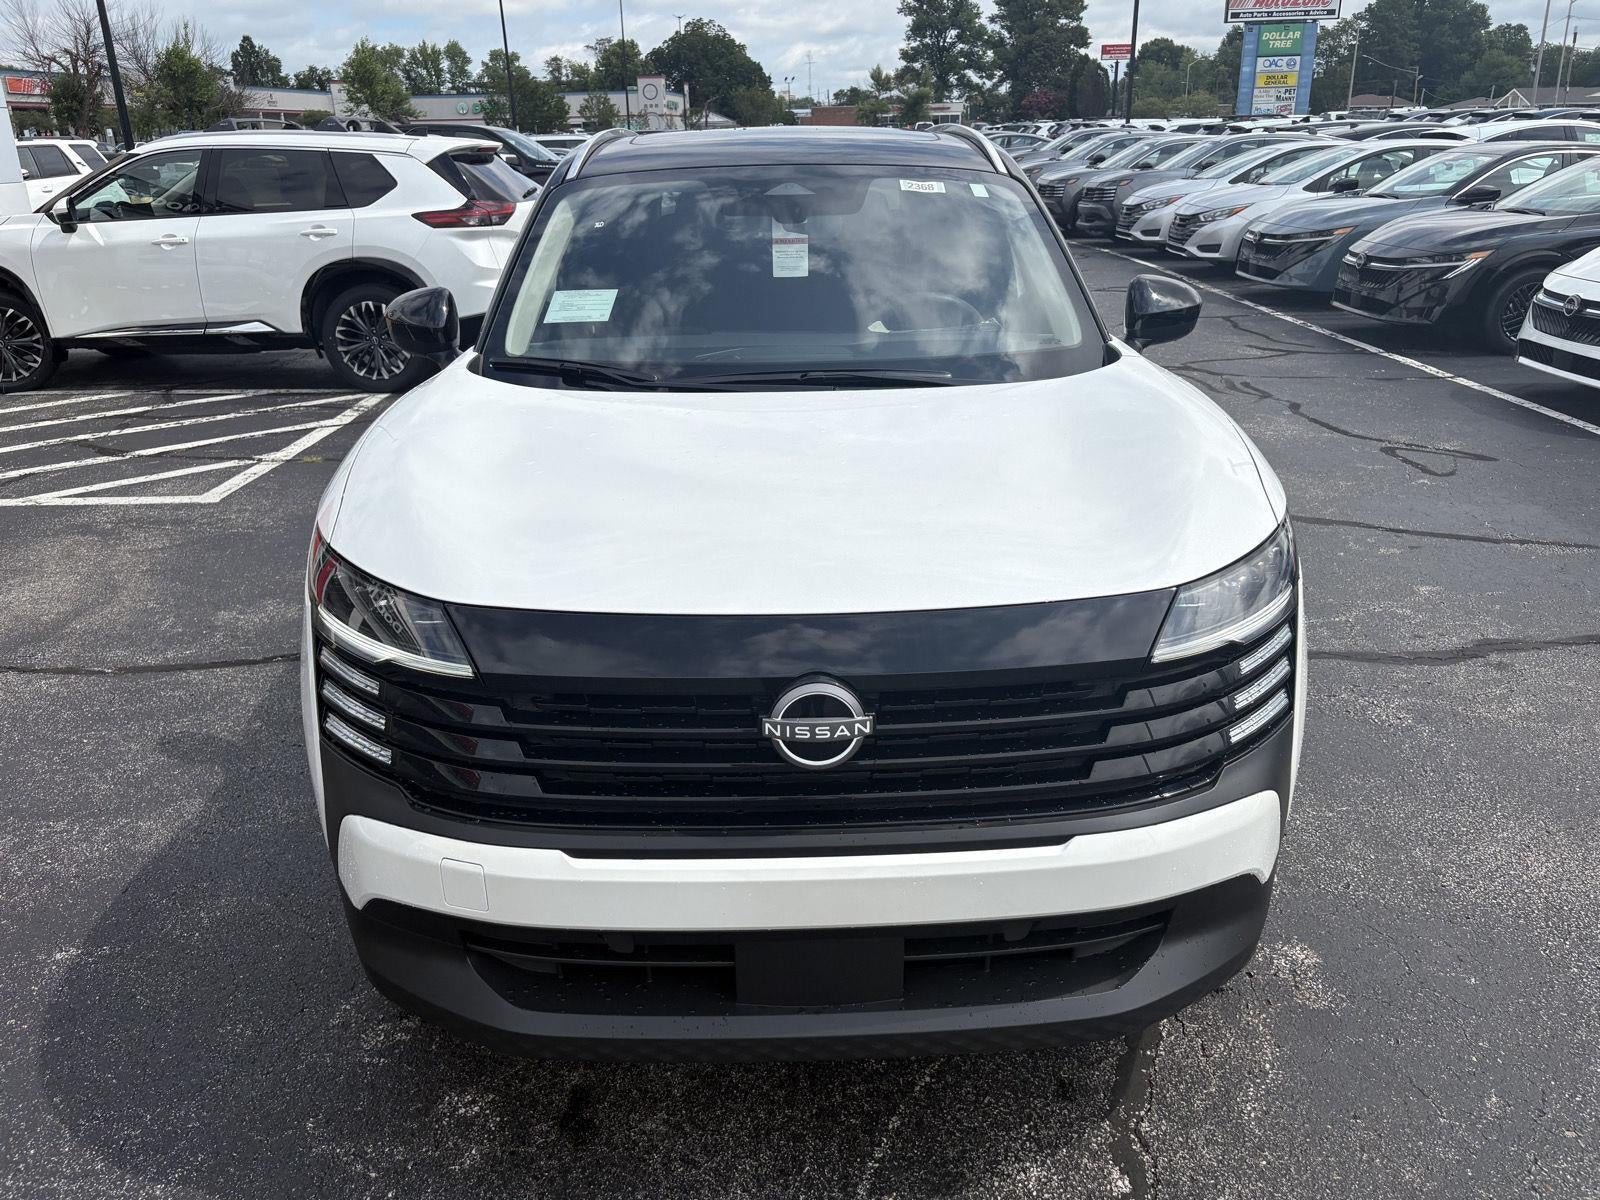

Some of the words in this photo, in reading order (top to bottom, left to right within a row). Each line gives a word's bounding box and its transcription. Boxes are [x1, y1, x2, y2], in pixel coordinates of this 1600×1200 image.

[1262, 31, 1301, 40] DOLLAR
[1269, 40, 1293, 48] TREE
[1263, 58, 1283, 68] OAC
[1284, 88, 1296, 96] PET
[907, 182, 935, 191] 2368
[765, 720, 870, 739] NISSAN
